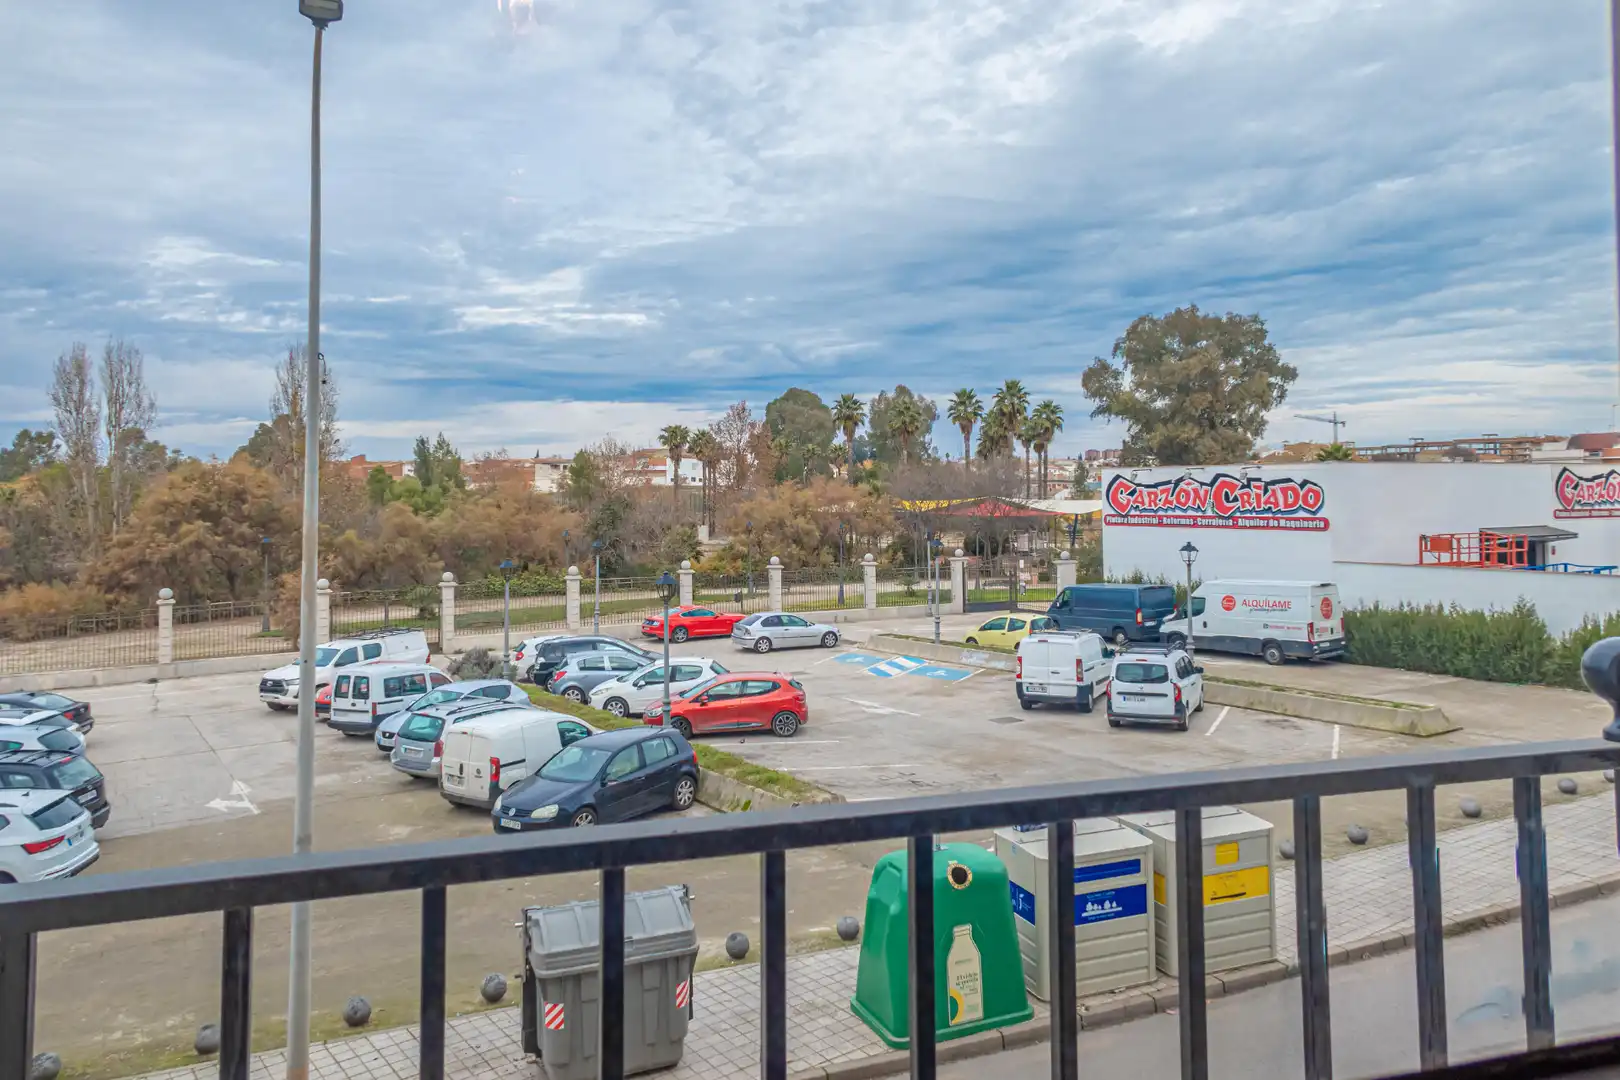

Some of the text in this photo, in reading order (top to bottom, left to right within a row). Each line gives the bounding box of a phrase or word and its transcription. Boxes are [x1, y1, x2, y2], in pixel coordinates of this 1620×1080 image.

[1212, 475, 1325, 517] CRIADO
[1128, 516, 1159, 525] Industrial
[1163, 517, 1194, 525] Reformas
[1238, 518, 1268, 528] Alquiler
[1269, 519, 1279, 527] de
